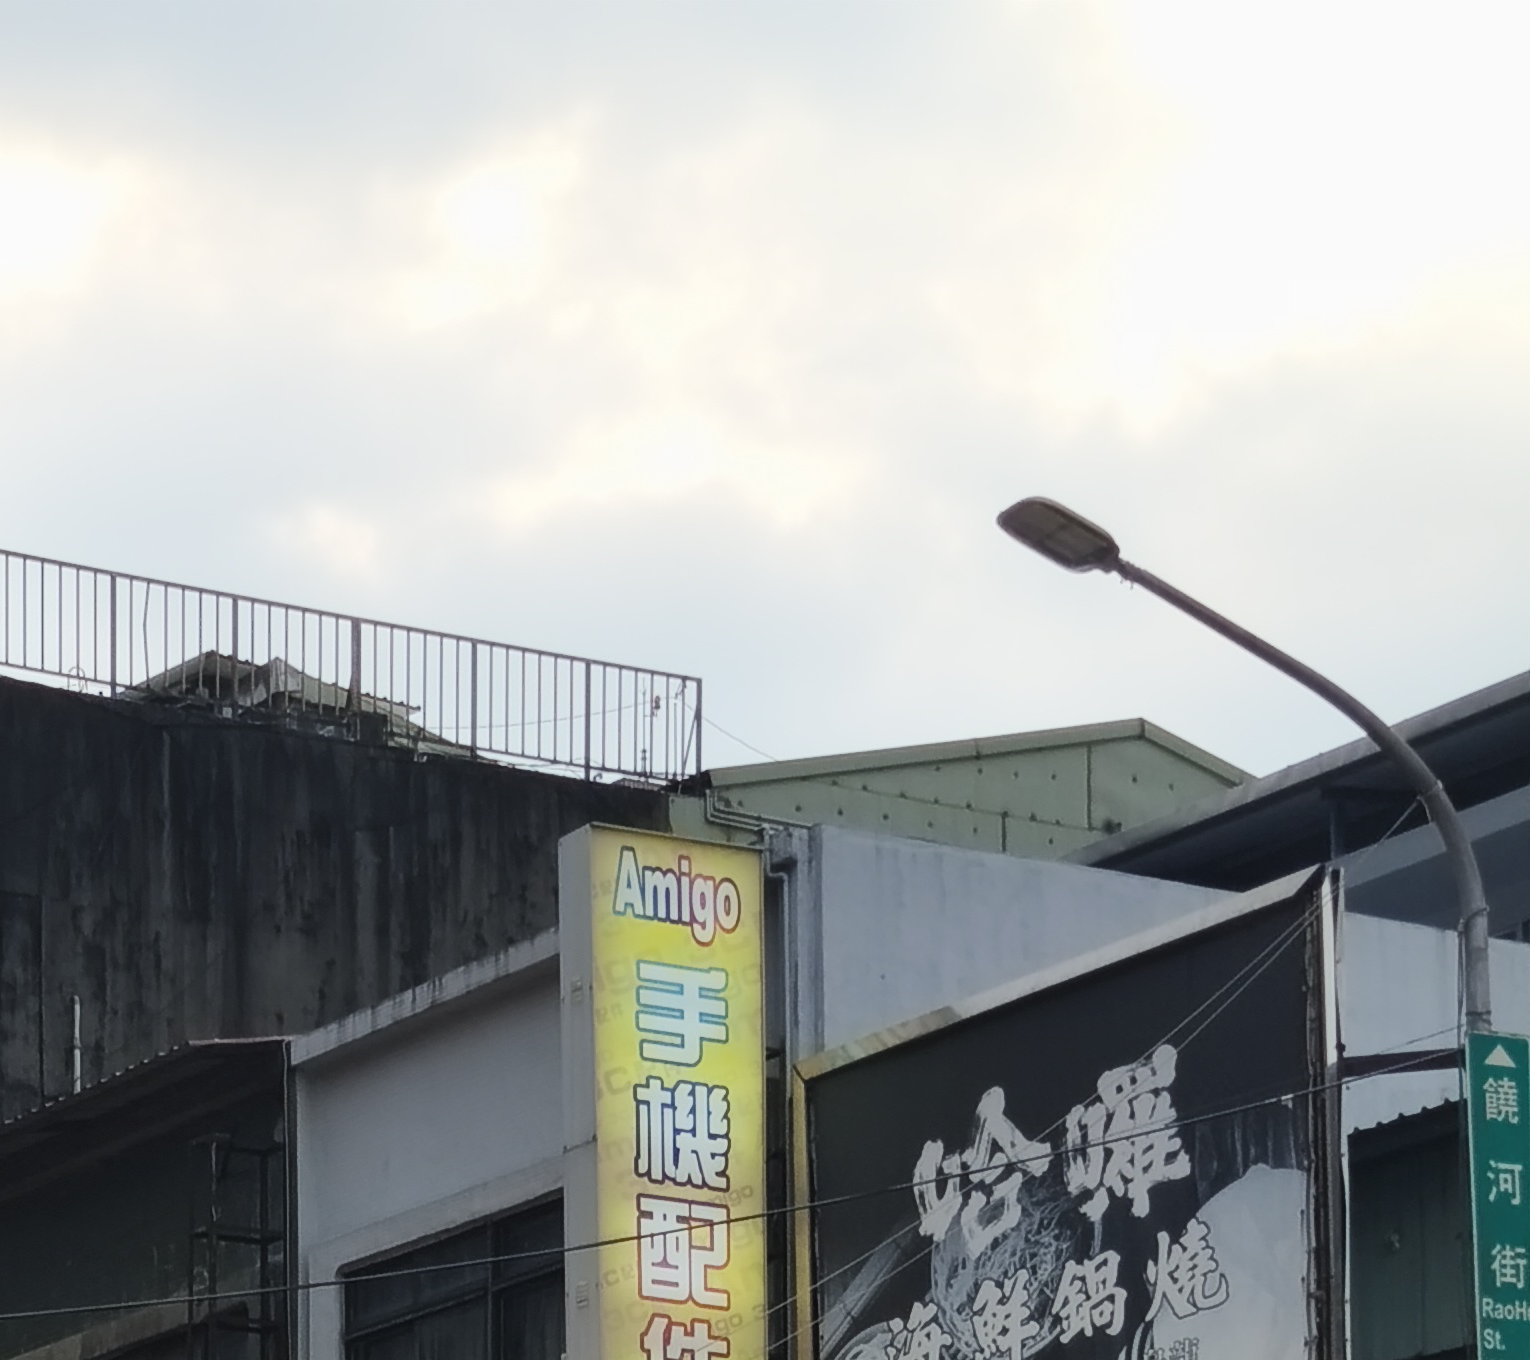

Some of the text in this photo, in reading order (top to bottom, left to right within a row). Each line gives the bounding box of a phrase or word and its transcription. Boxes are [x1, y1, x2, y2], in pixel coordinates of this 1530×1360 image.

[613, 845, 741, 947] Amigo
[1482, 1077, 1527, 1290] 饒河街
[1483, 1328, 1506, 1351] St.
